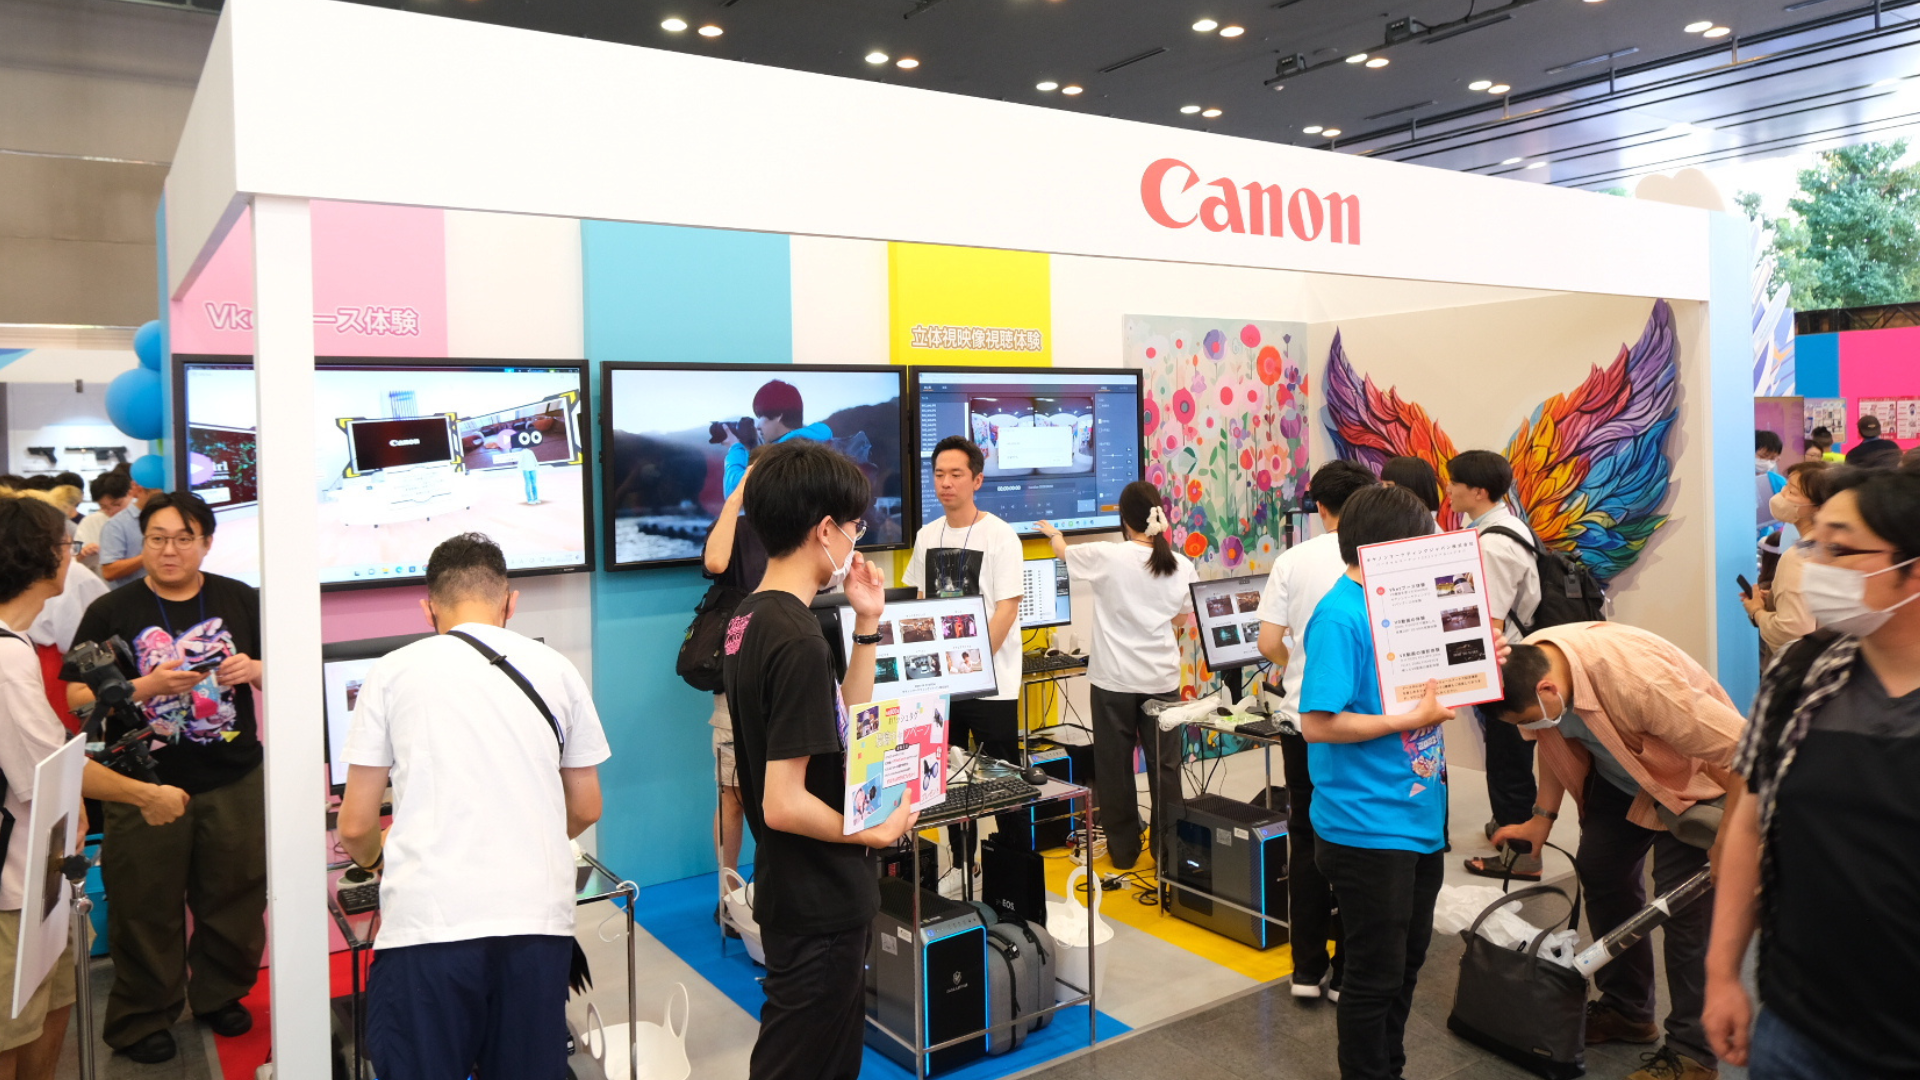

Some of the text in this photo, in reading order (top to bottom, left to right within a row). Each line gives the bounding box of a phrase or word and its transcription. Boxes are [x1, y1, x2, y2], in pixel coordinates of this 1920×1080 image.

[1141, 158, 1361, 245] Canon
[911, 325, 1042, 351] 立体視映像視聴体験
